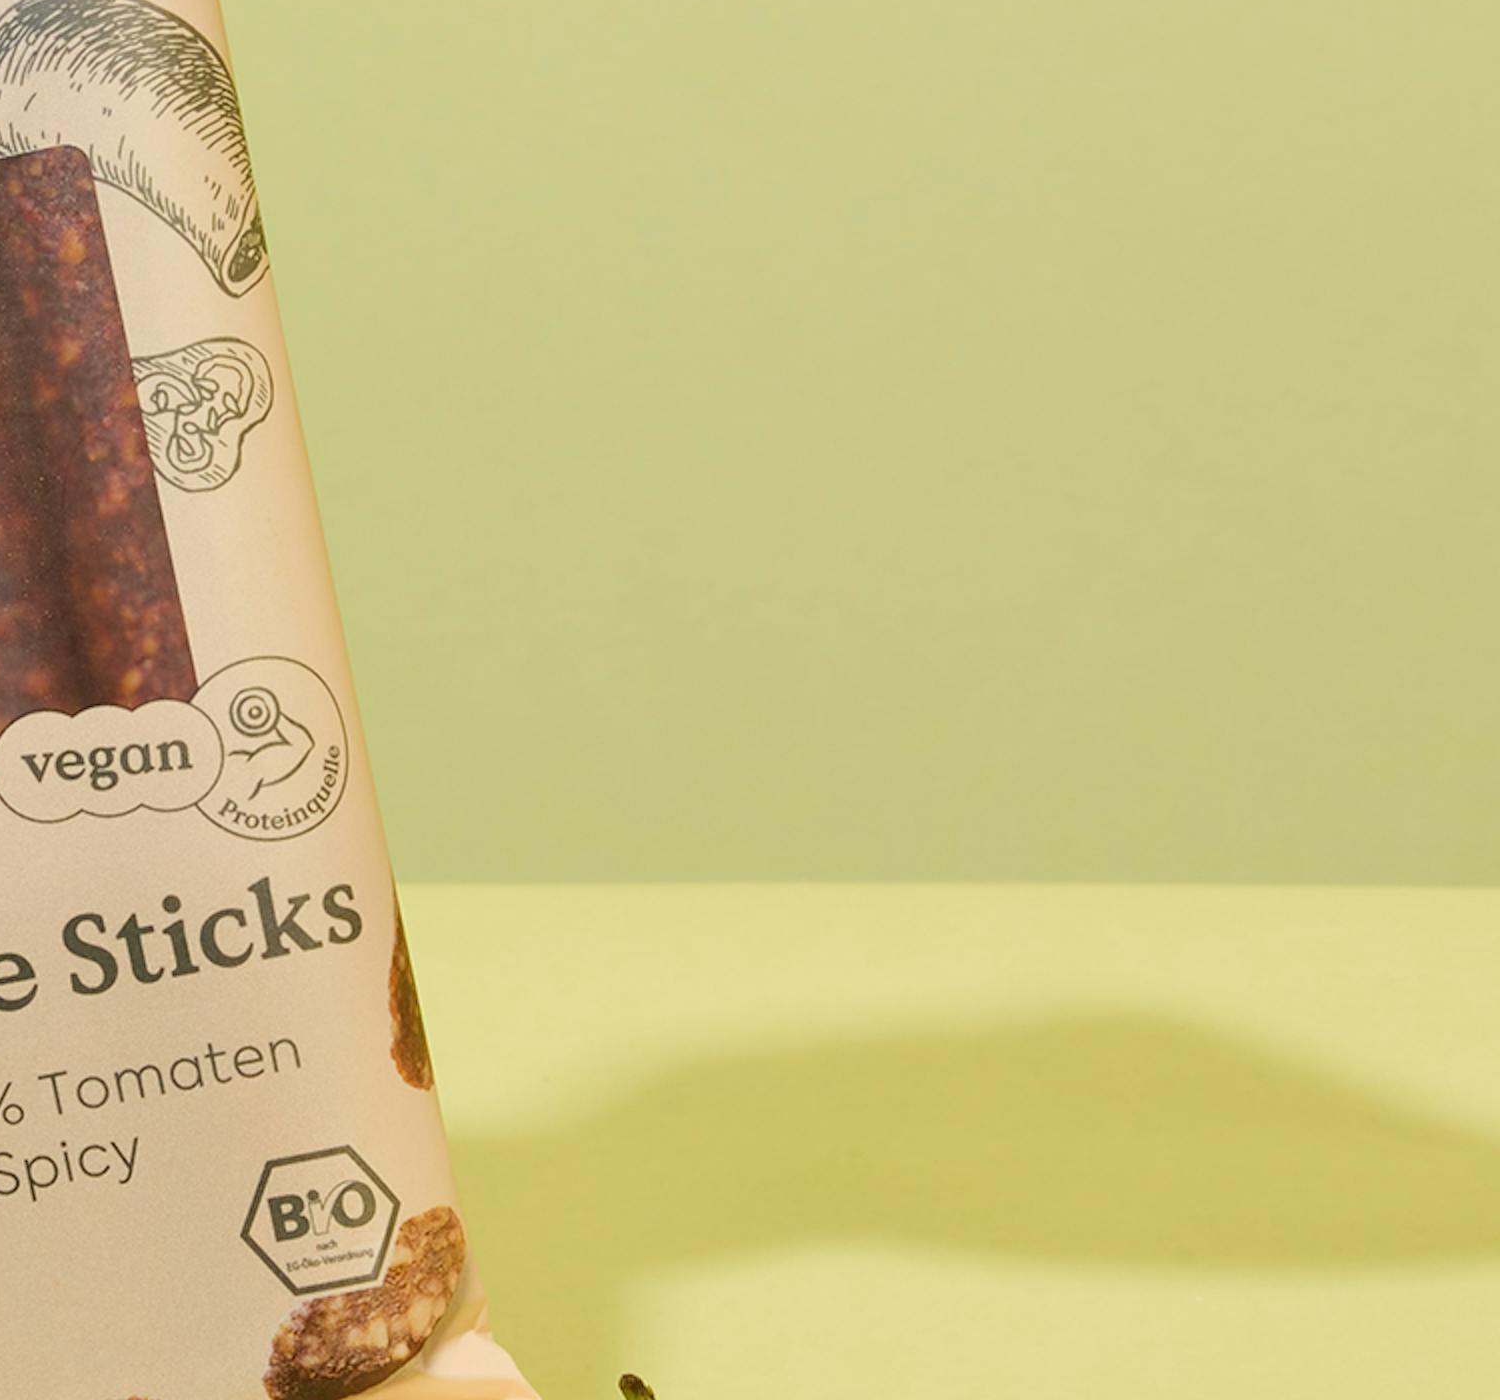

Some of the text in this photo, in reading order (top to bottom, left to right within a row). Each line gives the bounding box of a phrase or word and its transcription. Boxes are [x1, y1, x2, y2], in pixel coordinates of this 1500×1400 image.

[21, 737, 194, 790] vegan
[217, 744, 341, 831] Proteinquelle
[61, 876, 364, 996] Sticks
[39, 1037, 302, 1116] Tomaten
[316, 1239, 338, 1251] nach
